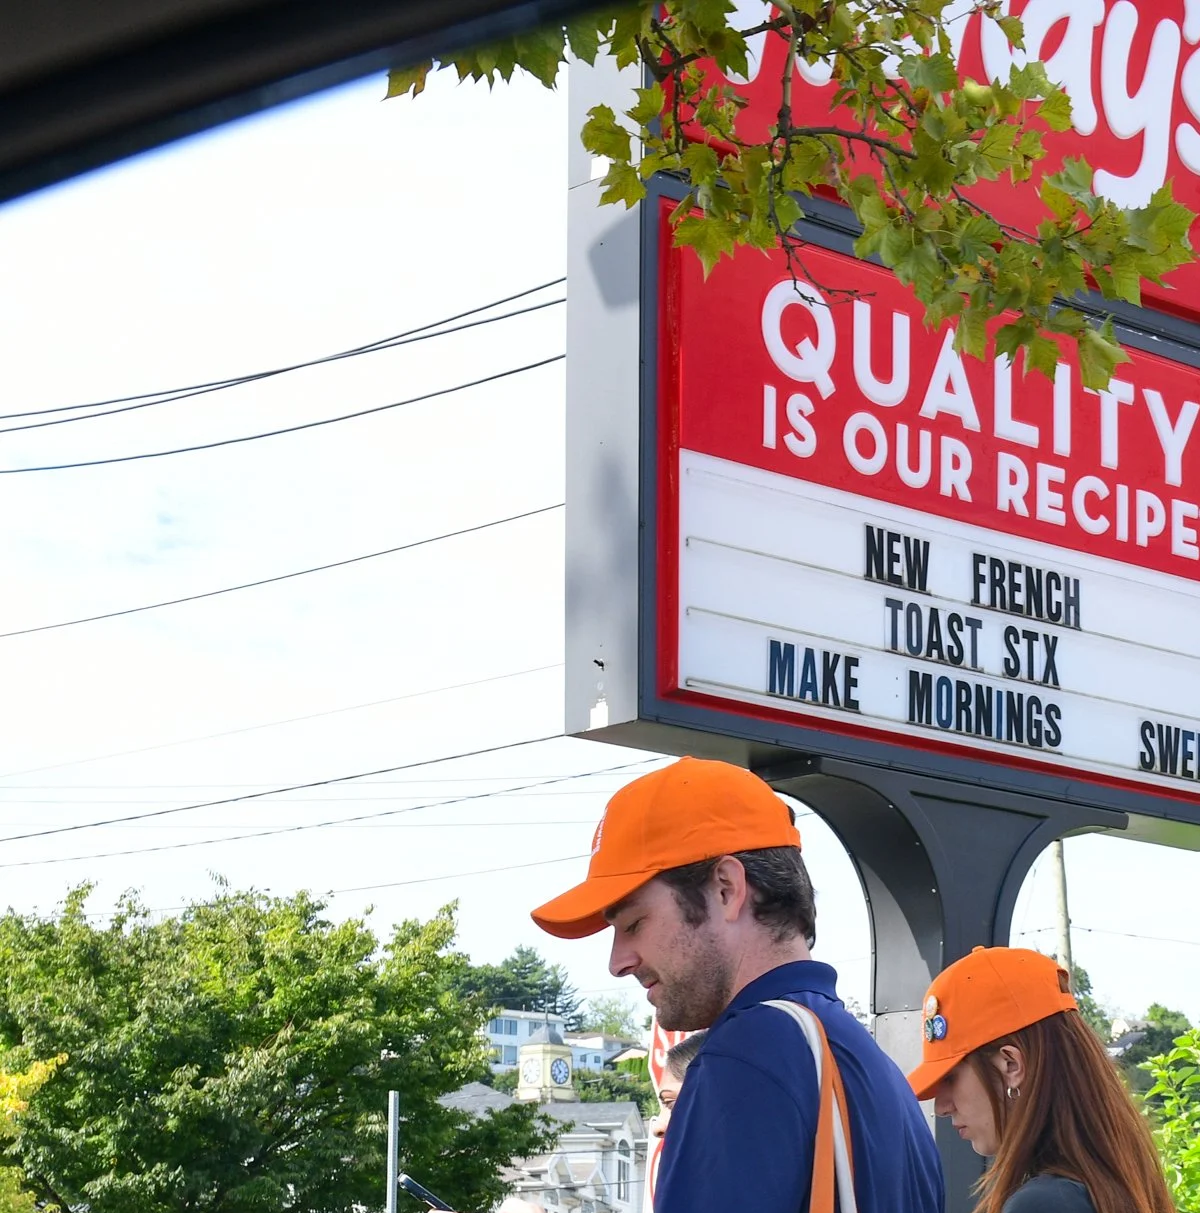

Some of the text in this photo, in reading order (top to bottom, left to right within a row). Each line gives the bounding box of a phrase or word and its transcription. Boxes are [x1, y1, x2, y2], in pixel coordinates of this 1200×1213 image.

[762, 280, 1200, 487] QUALITY
[763, 385, 817, 458] IS
[843, 412, 973, 502] OUR
[864, 525, 1080, 629] NEW FRENCH
[768, 639, 860, 710] MAKE
[908, 670, 1063, 748] MORNINGS
[886, 599, 1061, 686] TOAST STX
